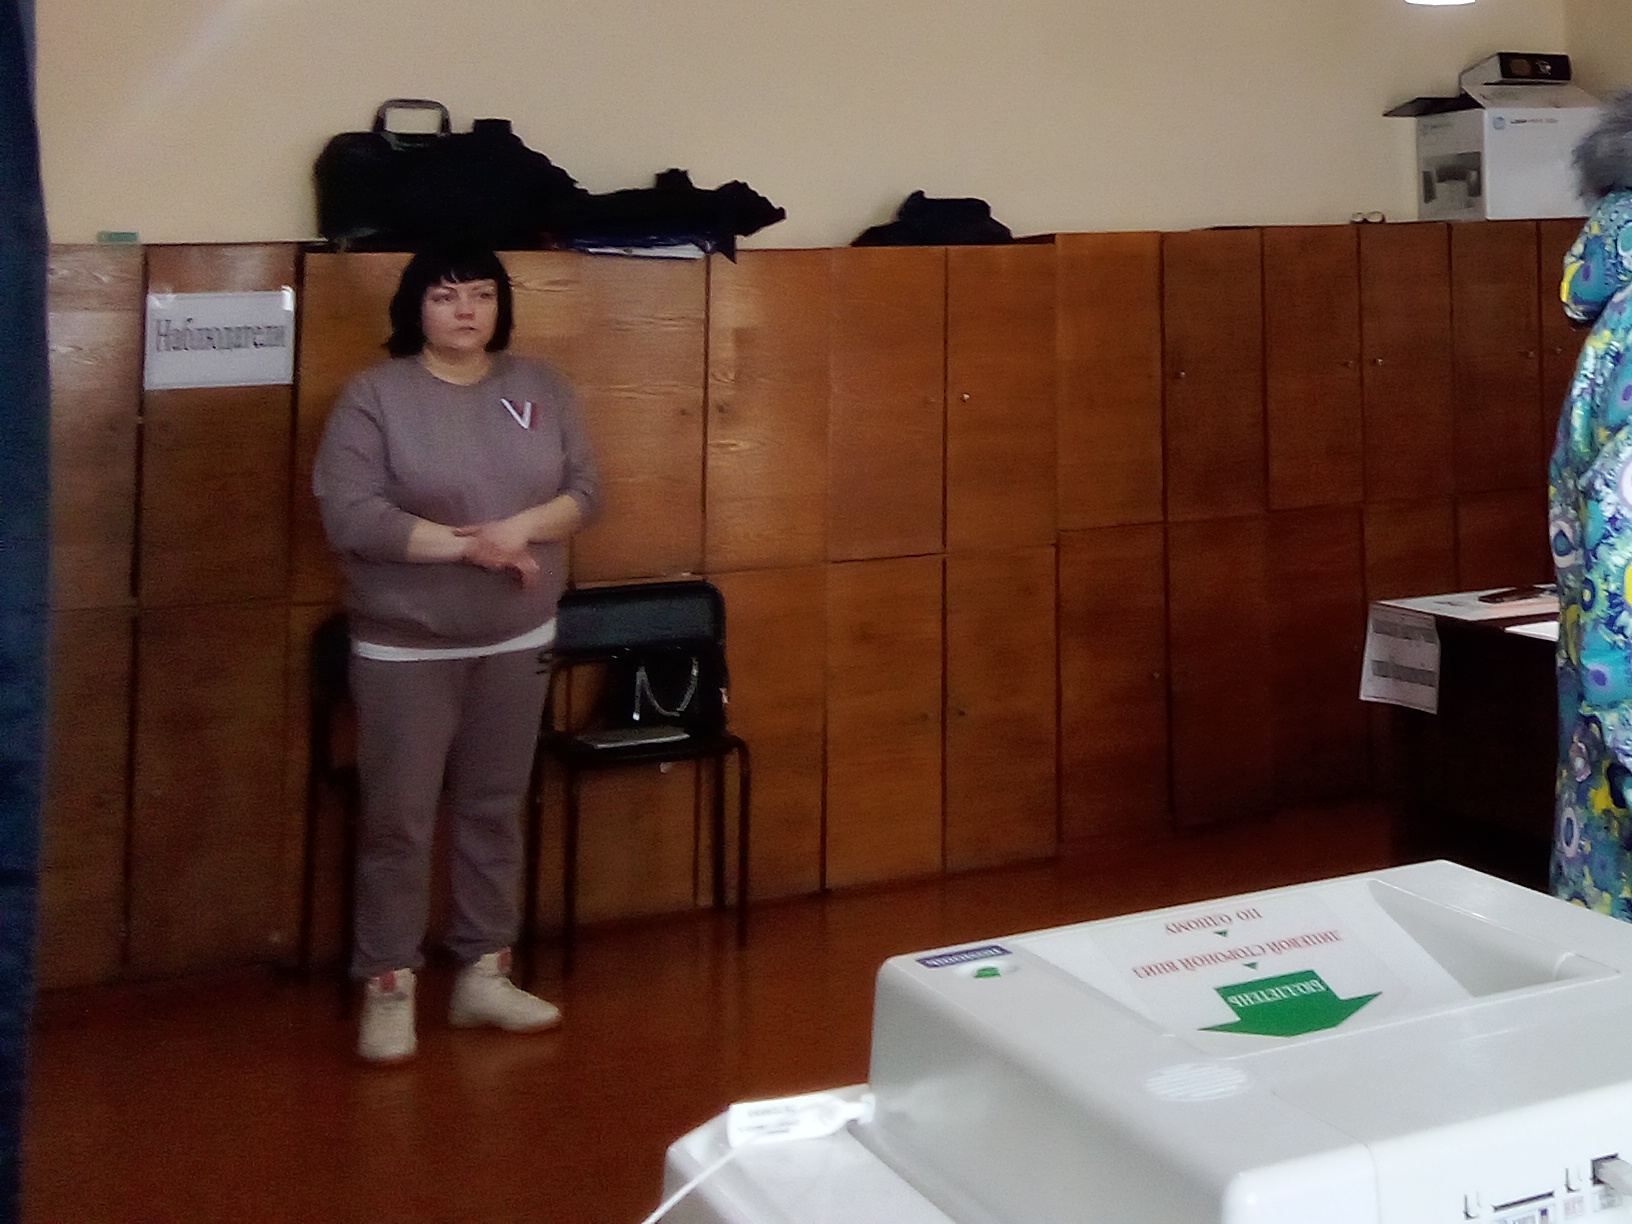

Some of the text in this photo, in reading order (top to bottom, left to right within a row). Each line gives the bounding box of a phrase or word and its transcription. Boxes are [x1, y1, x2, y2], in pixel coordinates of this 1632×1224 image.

[1165, 907, 1264, 934] ПО ОДНОМУ
[1131, 929, 1343, 979] ЛИЦЕВОЙ СТОРОНОЙ ВНИЗ
[1226, 979, 1328, 1008] БЮЛЛЕТЕНЬ
